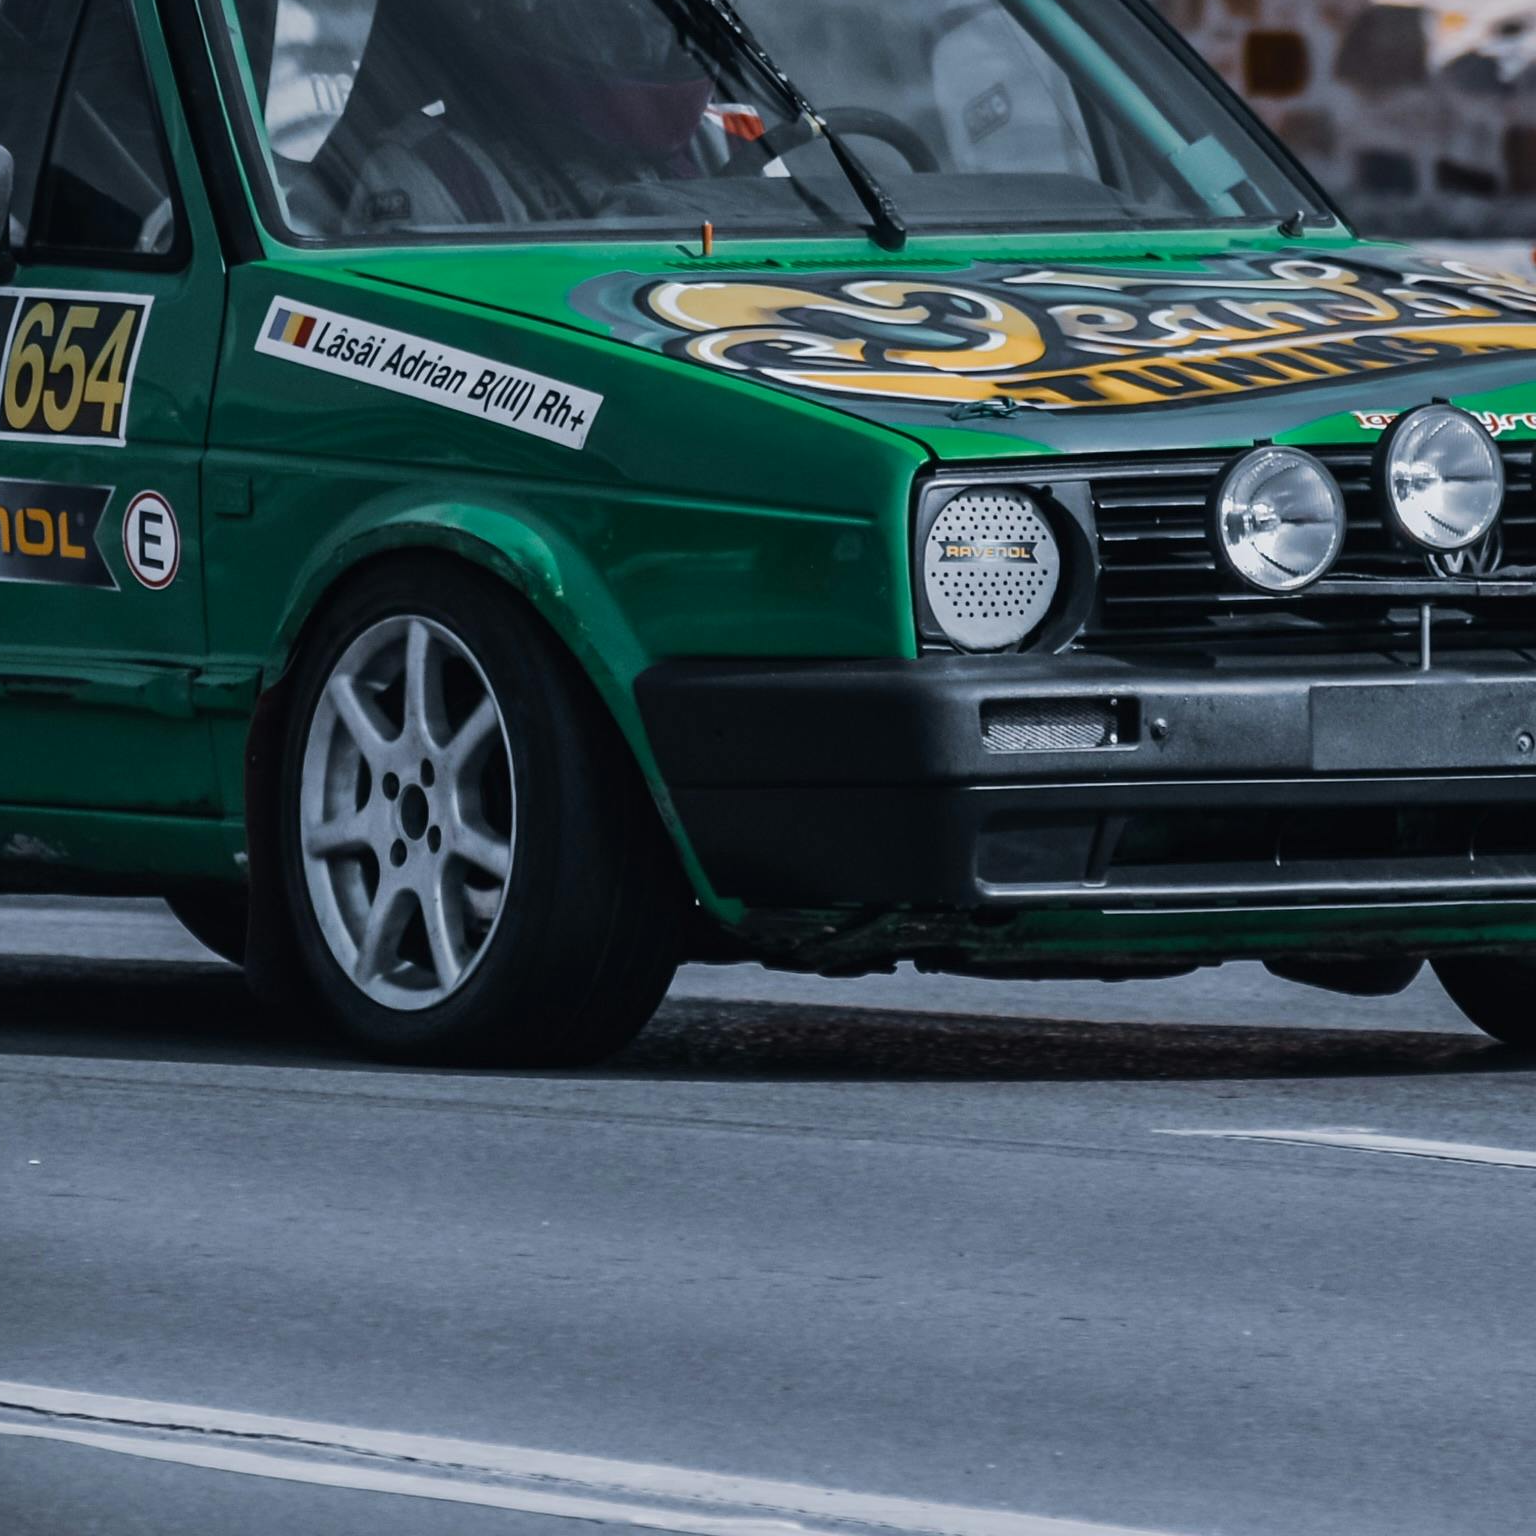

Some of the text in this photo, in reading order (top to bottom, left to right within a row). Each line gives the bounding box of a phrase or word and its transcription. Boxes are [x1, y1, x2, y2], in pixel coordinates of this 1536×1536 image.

[4, 301, 137, 433] 654
[380, 343, 467, 395] Adrian
[533, 389, 585, 432] Rh+
[137, 509, 165, 570] E
[945, 545, 1031, 559] RAVENOL
